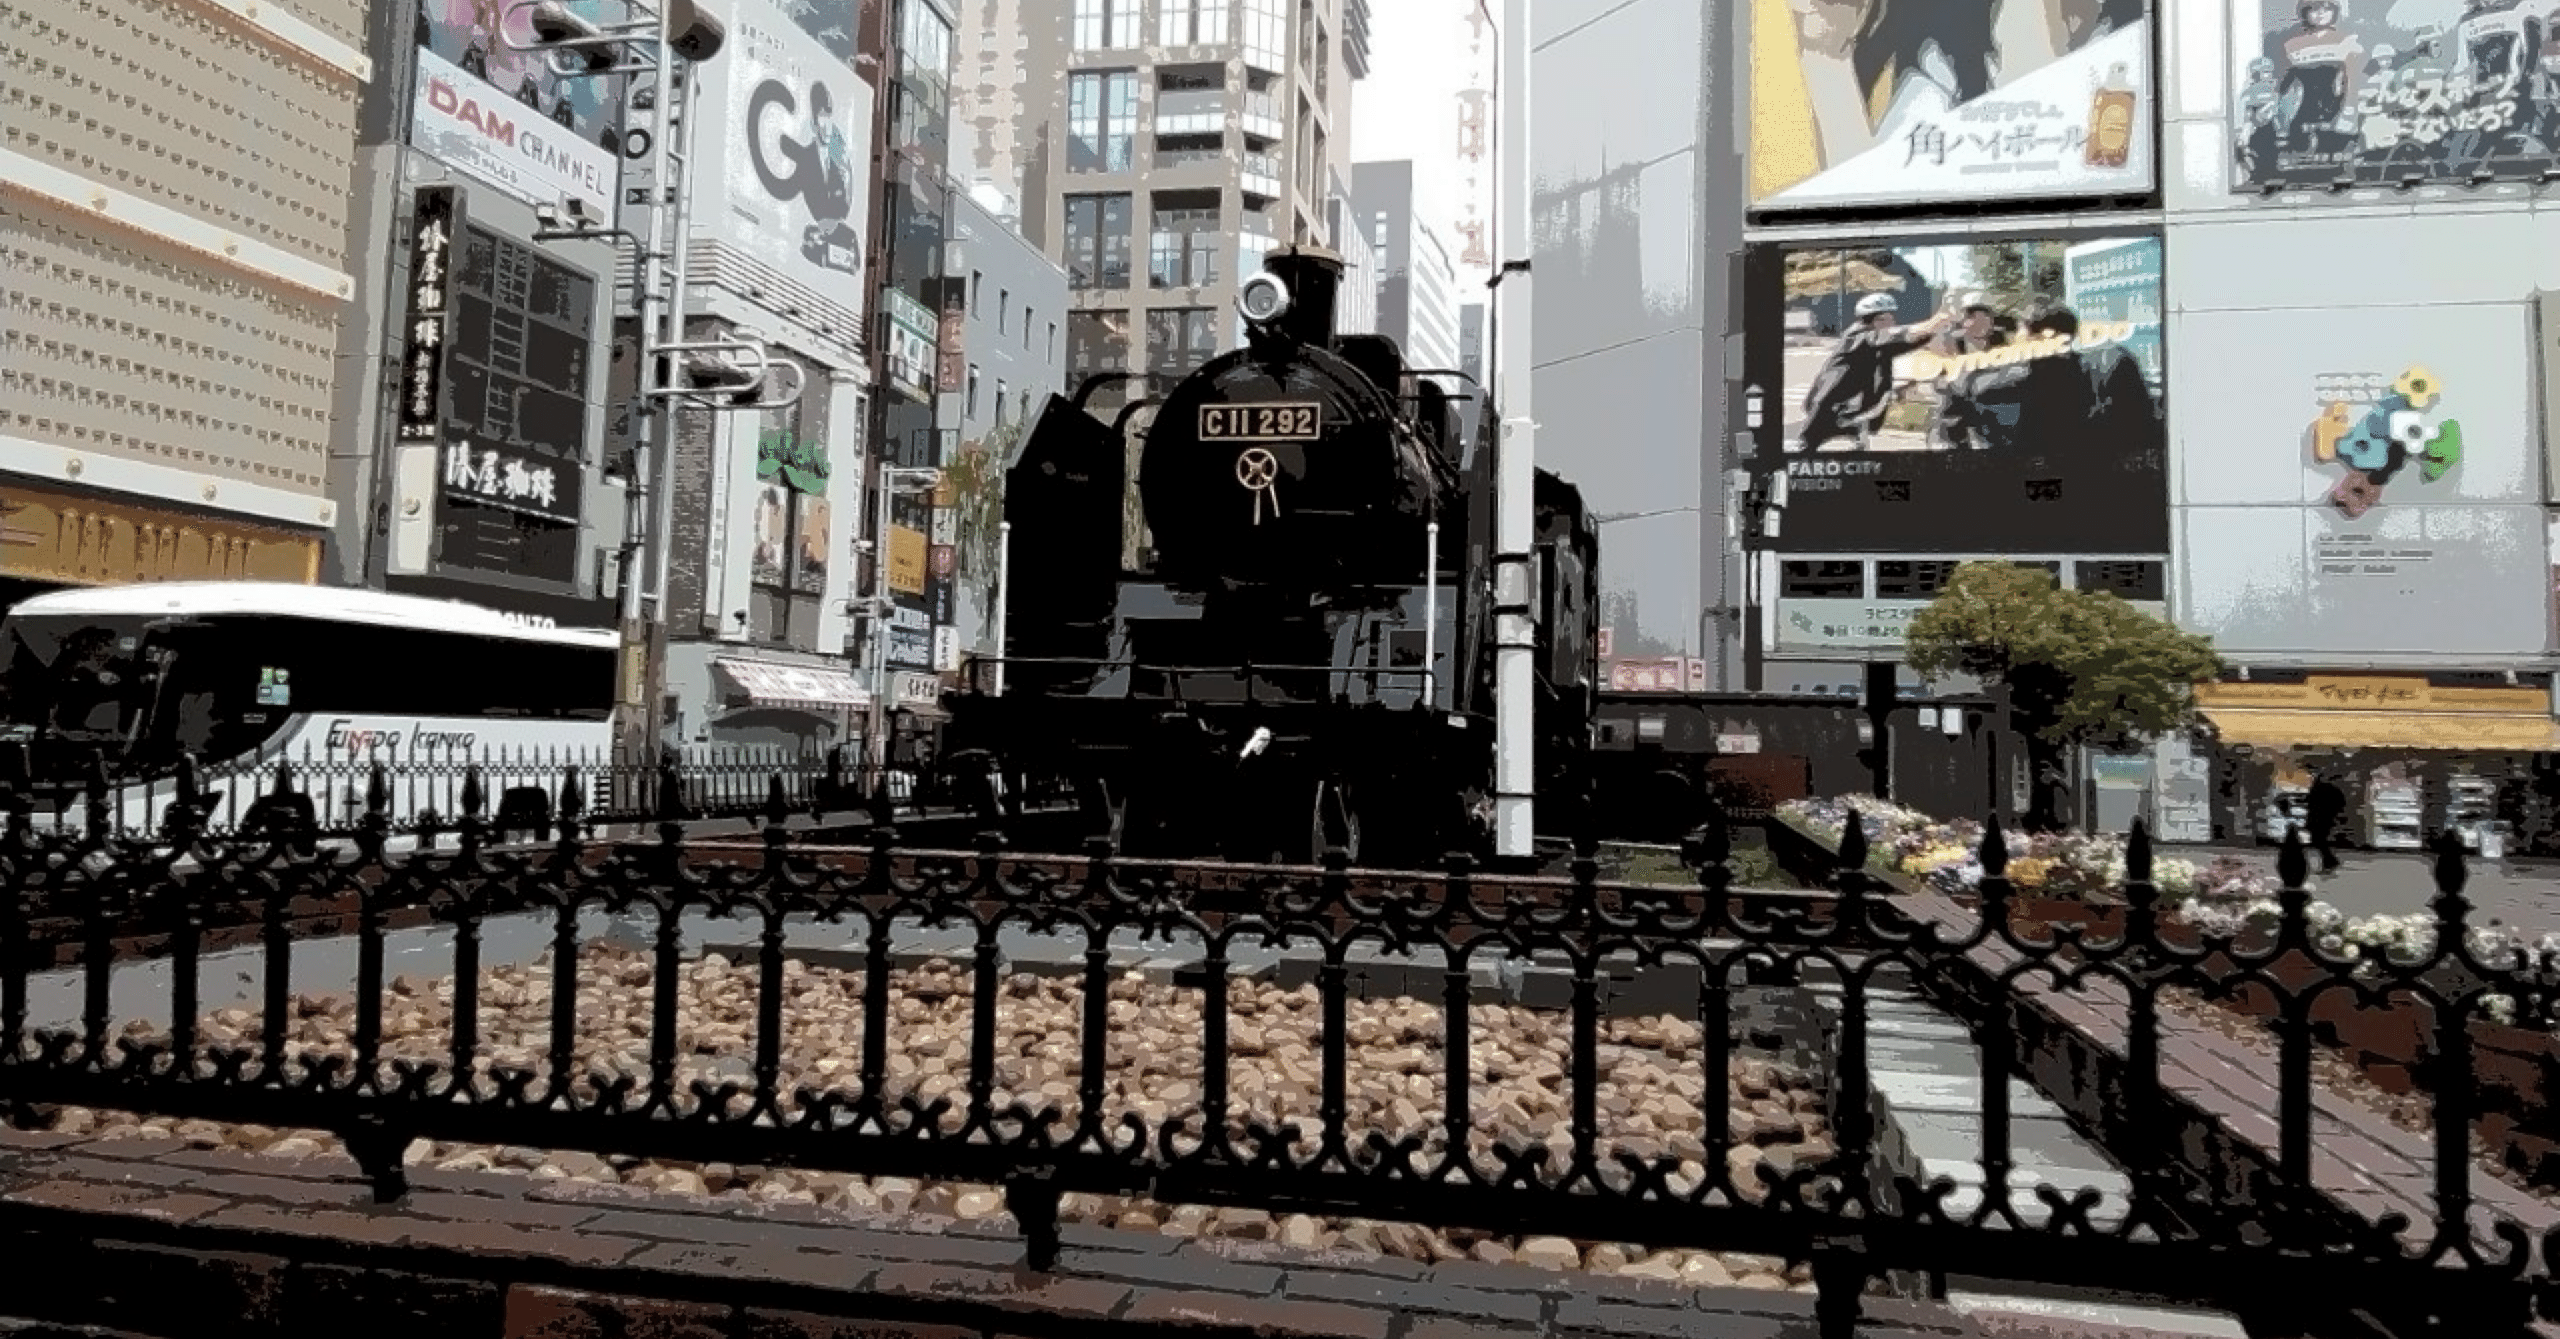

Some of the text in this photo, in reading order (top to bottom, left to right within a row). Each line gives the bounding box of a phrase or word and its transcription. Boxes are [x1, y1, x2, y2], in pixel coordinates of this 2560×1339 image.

[428, 77, 515, 147] DAM
[520, 131, 605, 196] CHANNEL
[1903, 120, 2091, 169] 角ハイボール
[1258, 409, 1313, 435] 292
[1788, 461, 1841, 476] FARO
